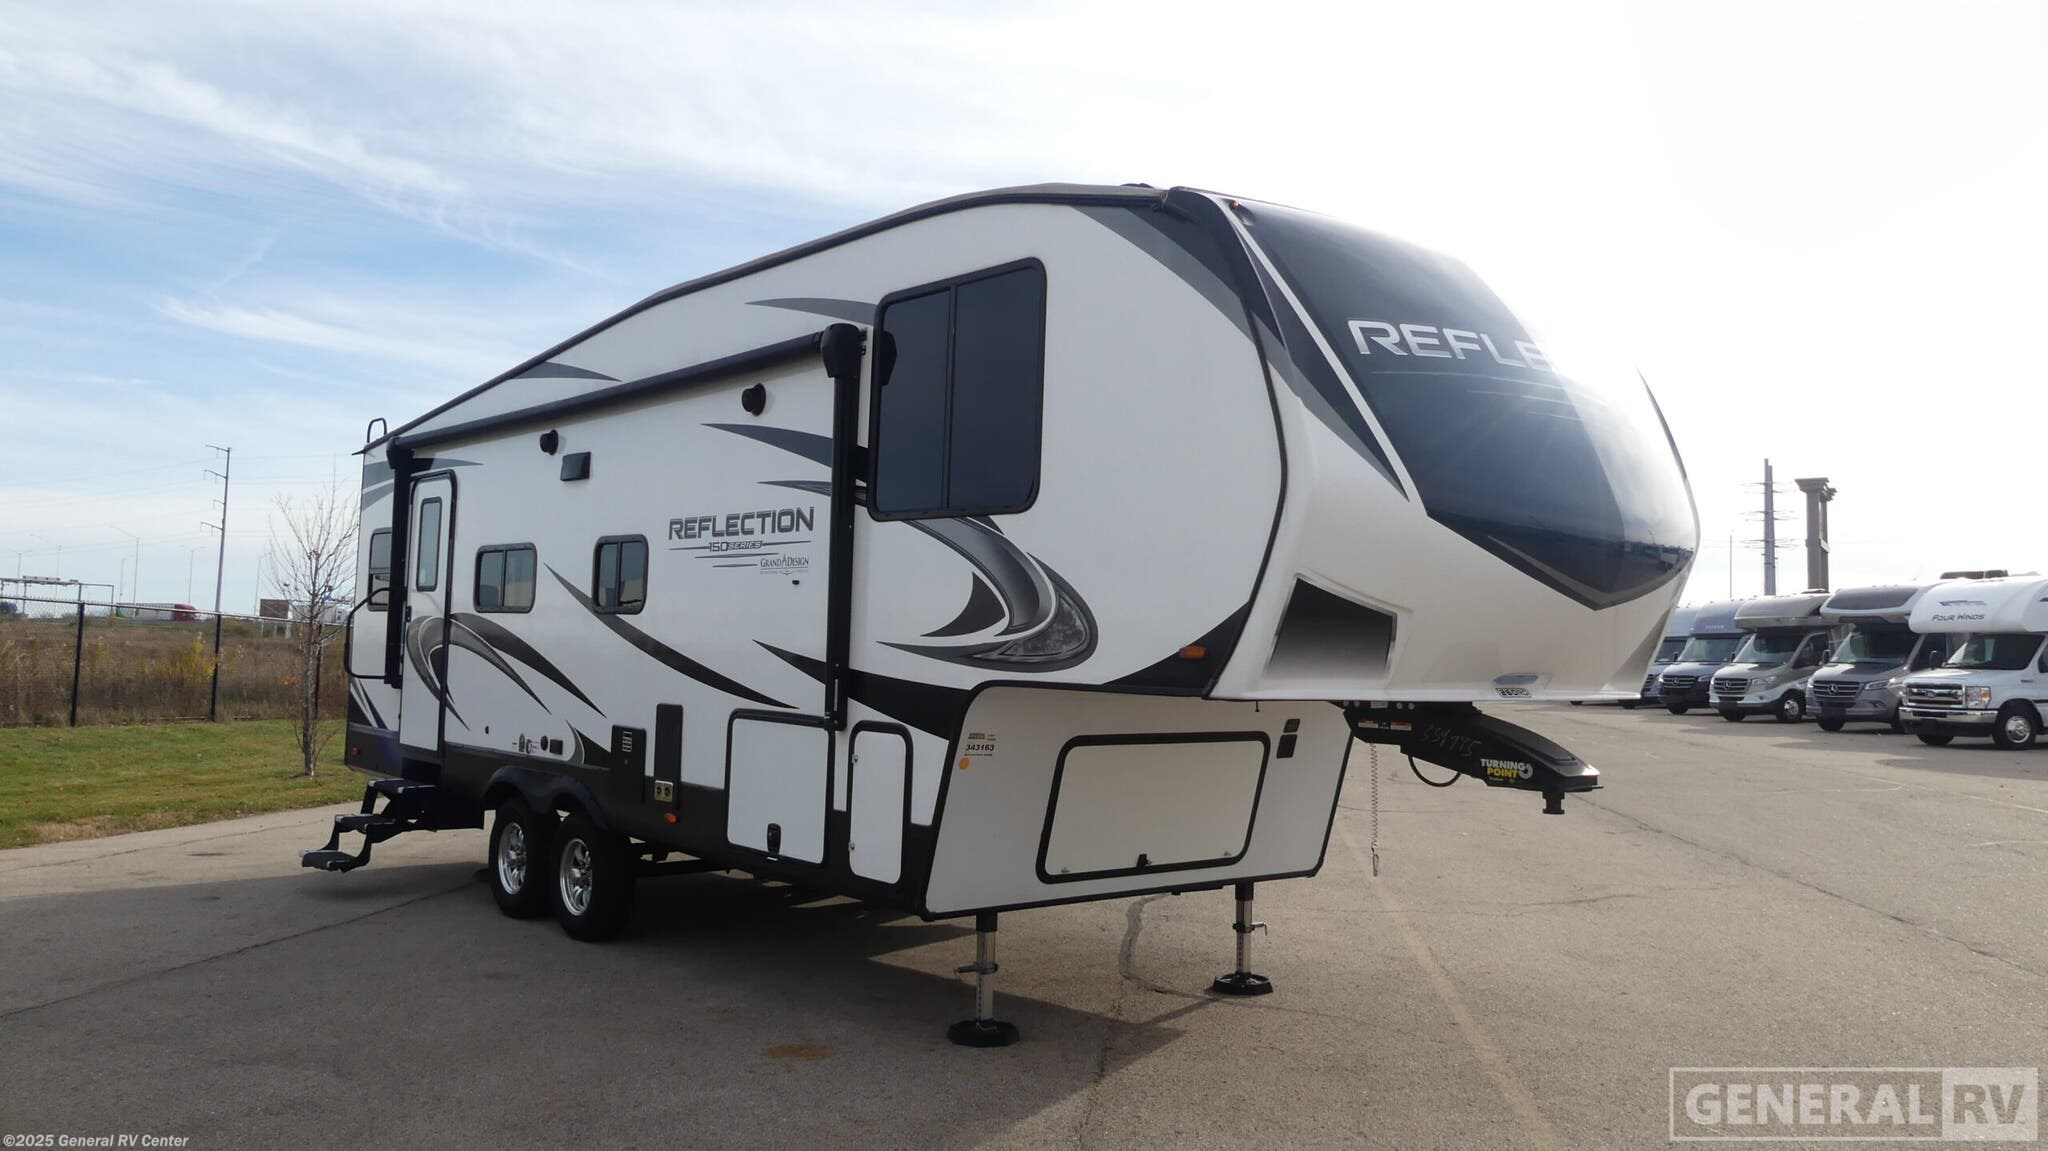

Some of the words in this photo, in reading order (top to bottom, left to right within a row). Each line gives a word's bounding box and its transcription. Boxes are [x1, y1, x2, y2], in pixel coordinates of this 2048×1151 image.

[668, 506, 815, 540] REFLECTION
[1957, 613, 1985, 621] WINDS
[965, 743, 995, 752] 343163
[1480, 758, 1526, 771] TURNING
[1487, 767, 1519, 778] POINT
